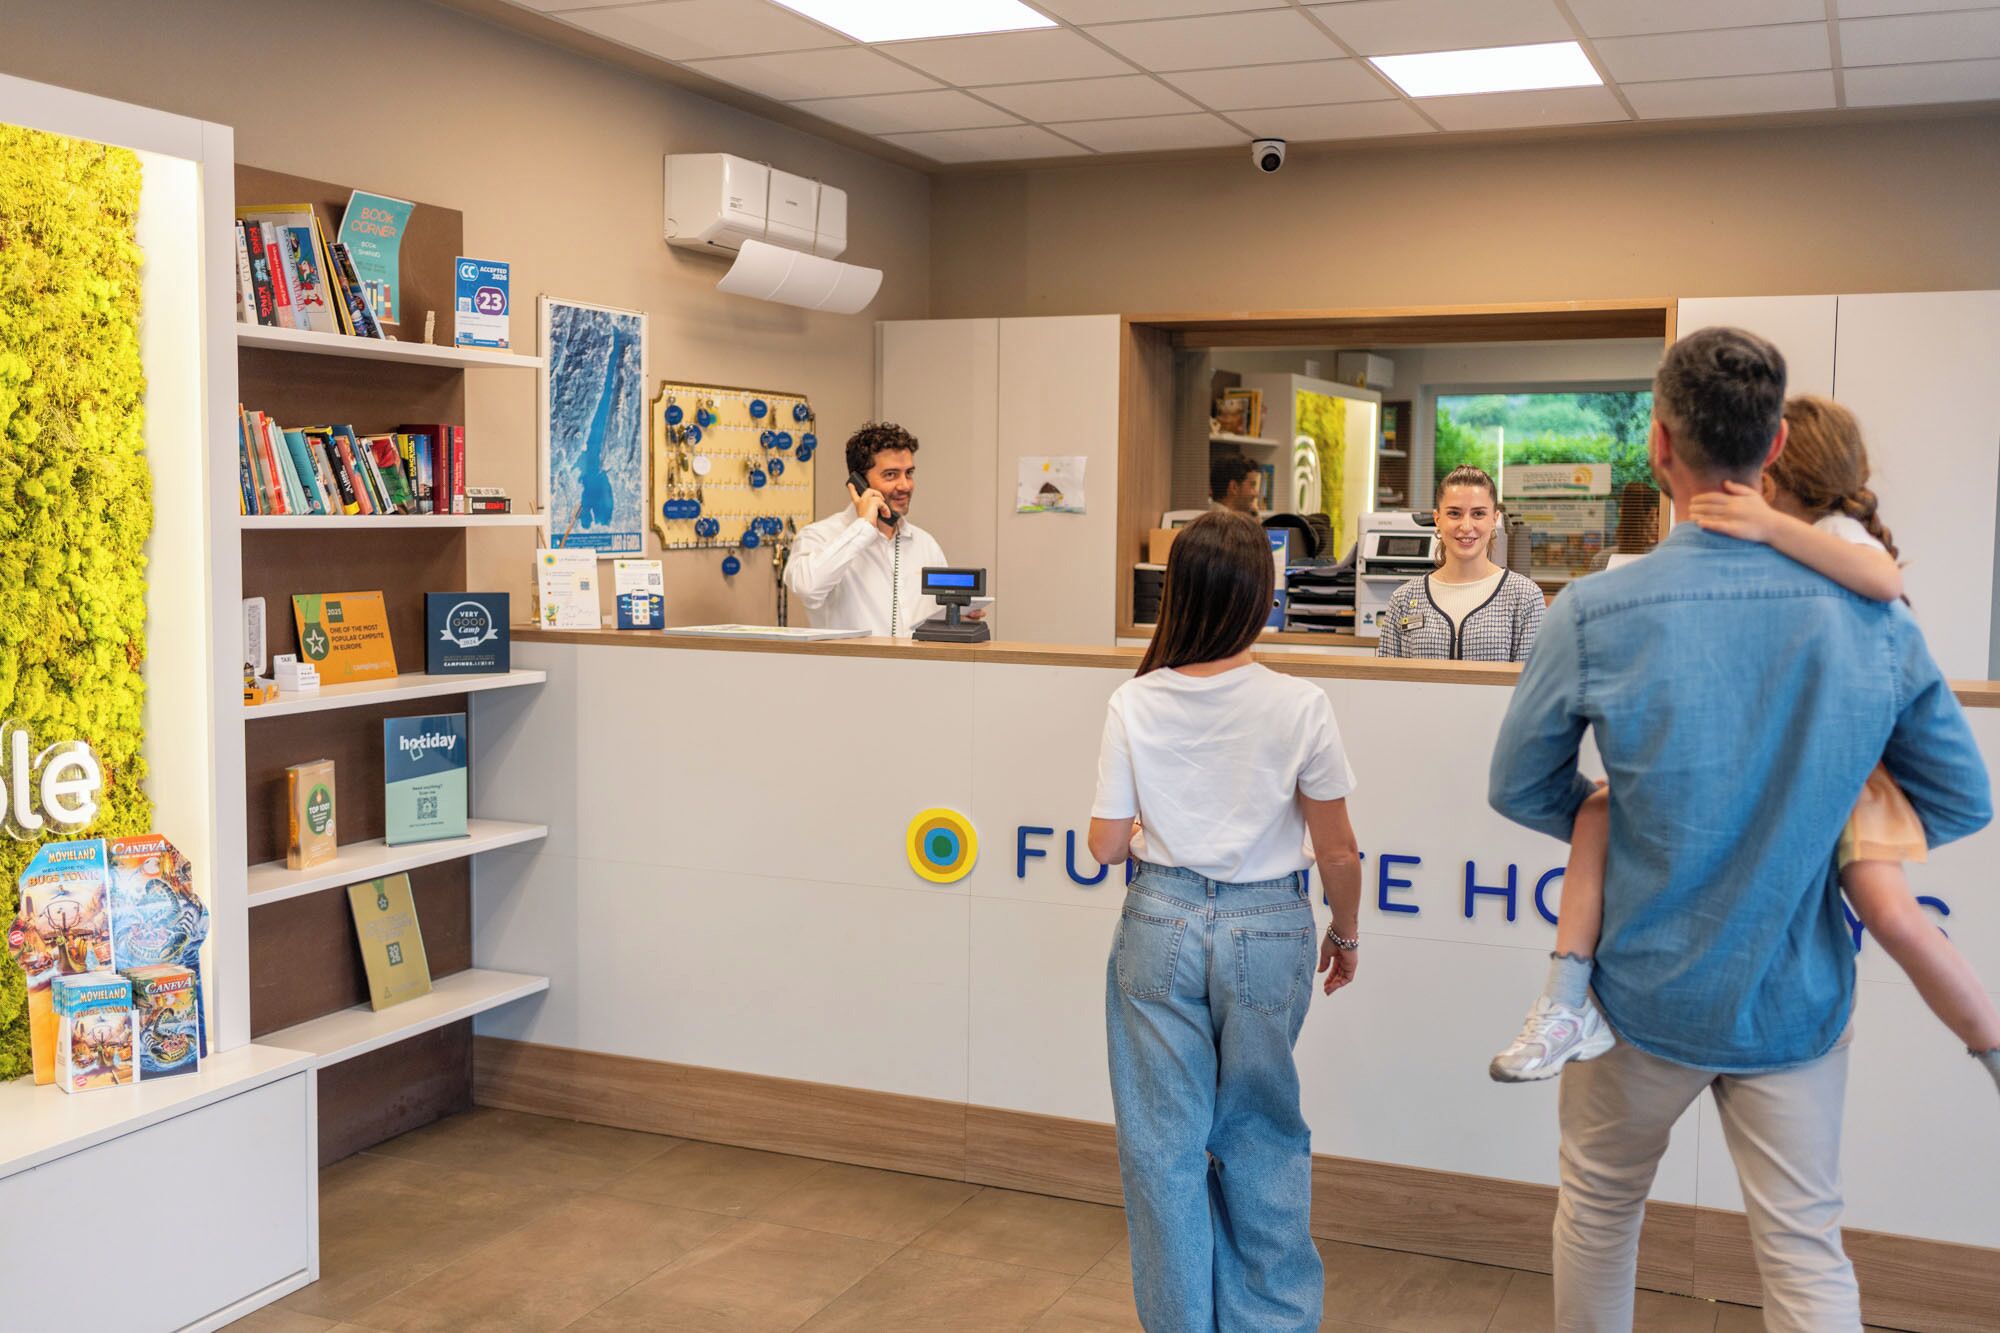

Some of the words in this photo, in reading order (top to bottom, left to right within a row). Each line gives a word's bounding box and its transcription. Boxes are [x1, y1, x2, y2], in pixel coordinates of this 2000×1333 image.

[360, 207, 394, 224] BOOK
[351, 220, 397, 238] CORNER
[249, 226, 261, 255] KING
[240, 249, 251, 283] ITALY
[461, 265, 475, 278] CC
[480, 266, 507, 275] ACCEPTED
[328, 608, 342, 616] 2025
[453, 618, 485, 626] GOOD
[330, 626, 342, 634] ONE
[331, 634, 357, 642] POPULAR
[358, 632, 384, 640] CAMPSITE
[458, 626, 480, 635] Camp
[340, 643, 362, 651] EUROPE
[399, 732, 457, 751] hotiday
[0, 729, 101, 829] le
[111, 840, 168, 855] CANEVA
[48, 848, 96, 864] MOVIELAND
[27, 873, 60, 886] BUGS
[61, 871, 100, 881] TOWN
[145, 977, 192, 994] CANEVA
[79, 987, 127, 1003] MOVIELAND
